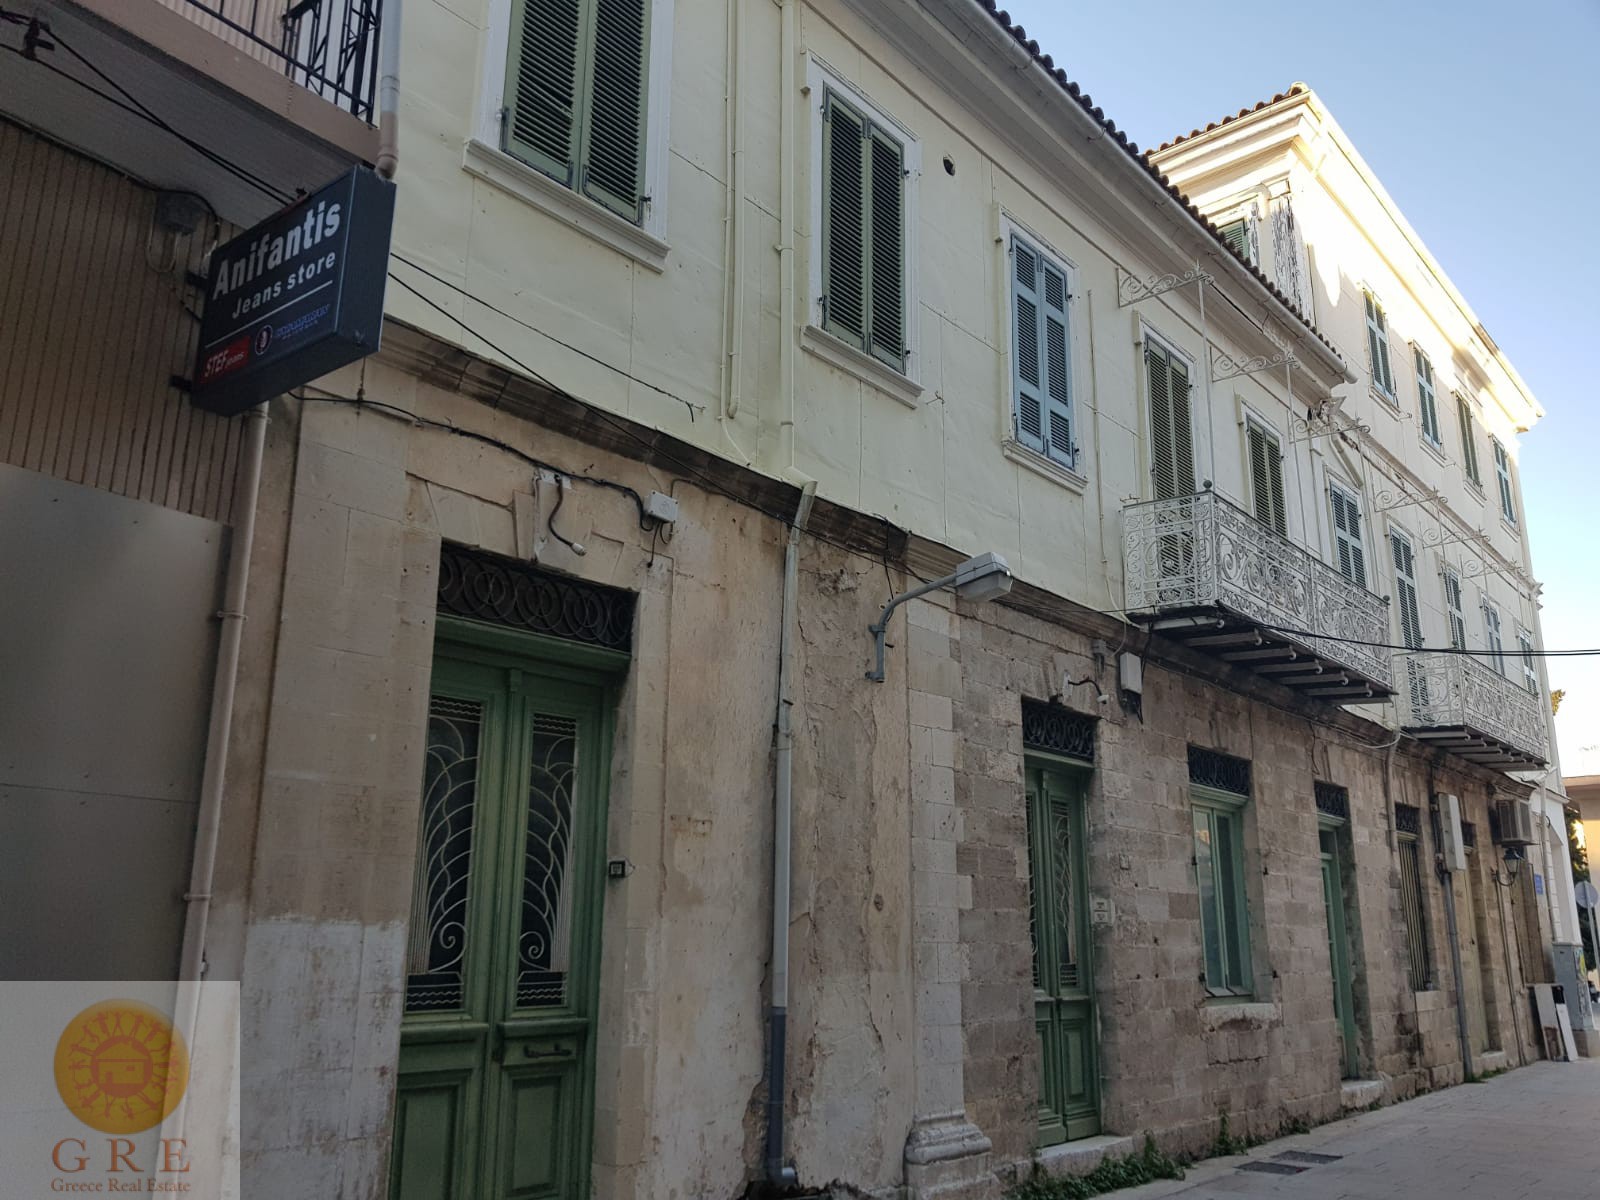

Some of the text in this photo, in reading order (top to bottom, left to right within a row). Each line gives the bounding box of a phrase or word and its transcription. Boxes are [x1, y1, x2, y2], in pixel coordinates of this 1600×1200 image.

[213, 201, 341, 300] Anifantis
[232, 281, 282, 319] Jeans
[287, 251, 336, 290] store
